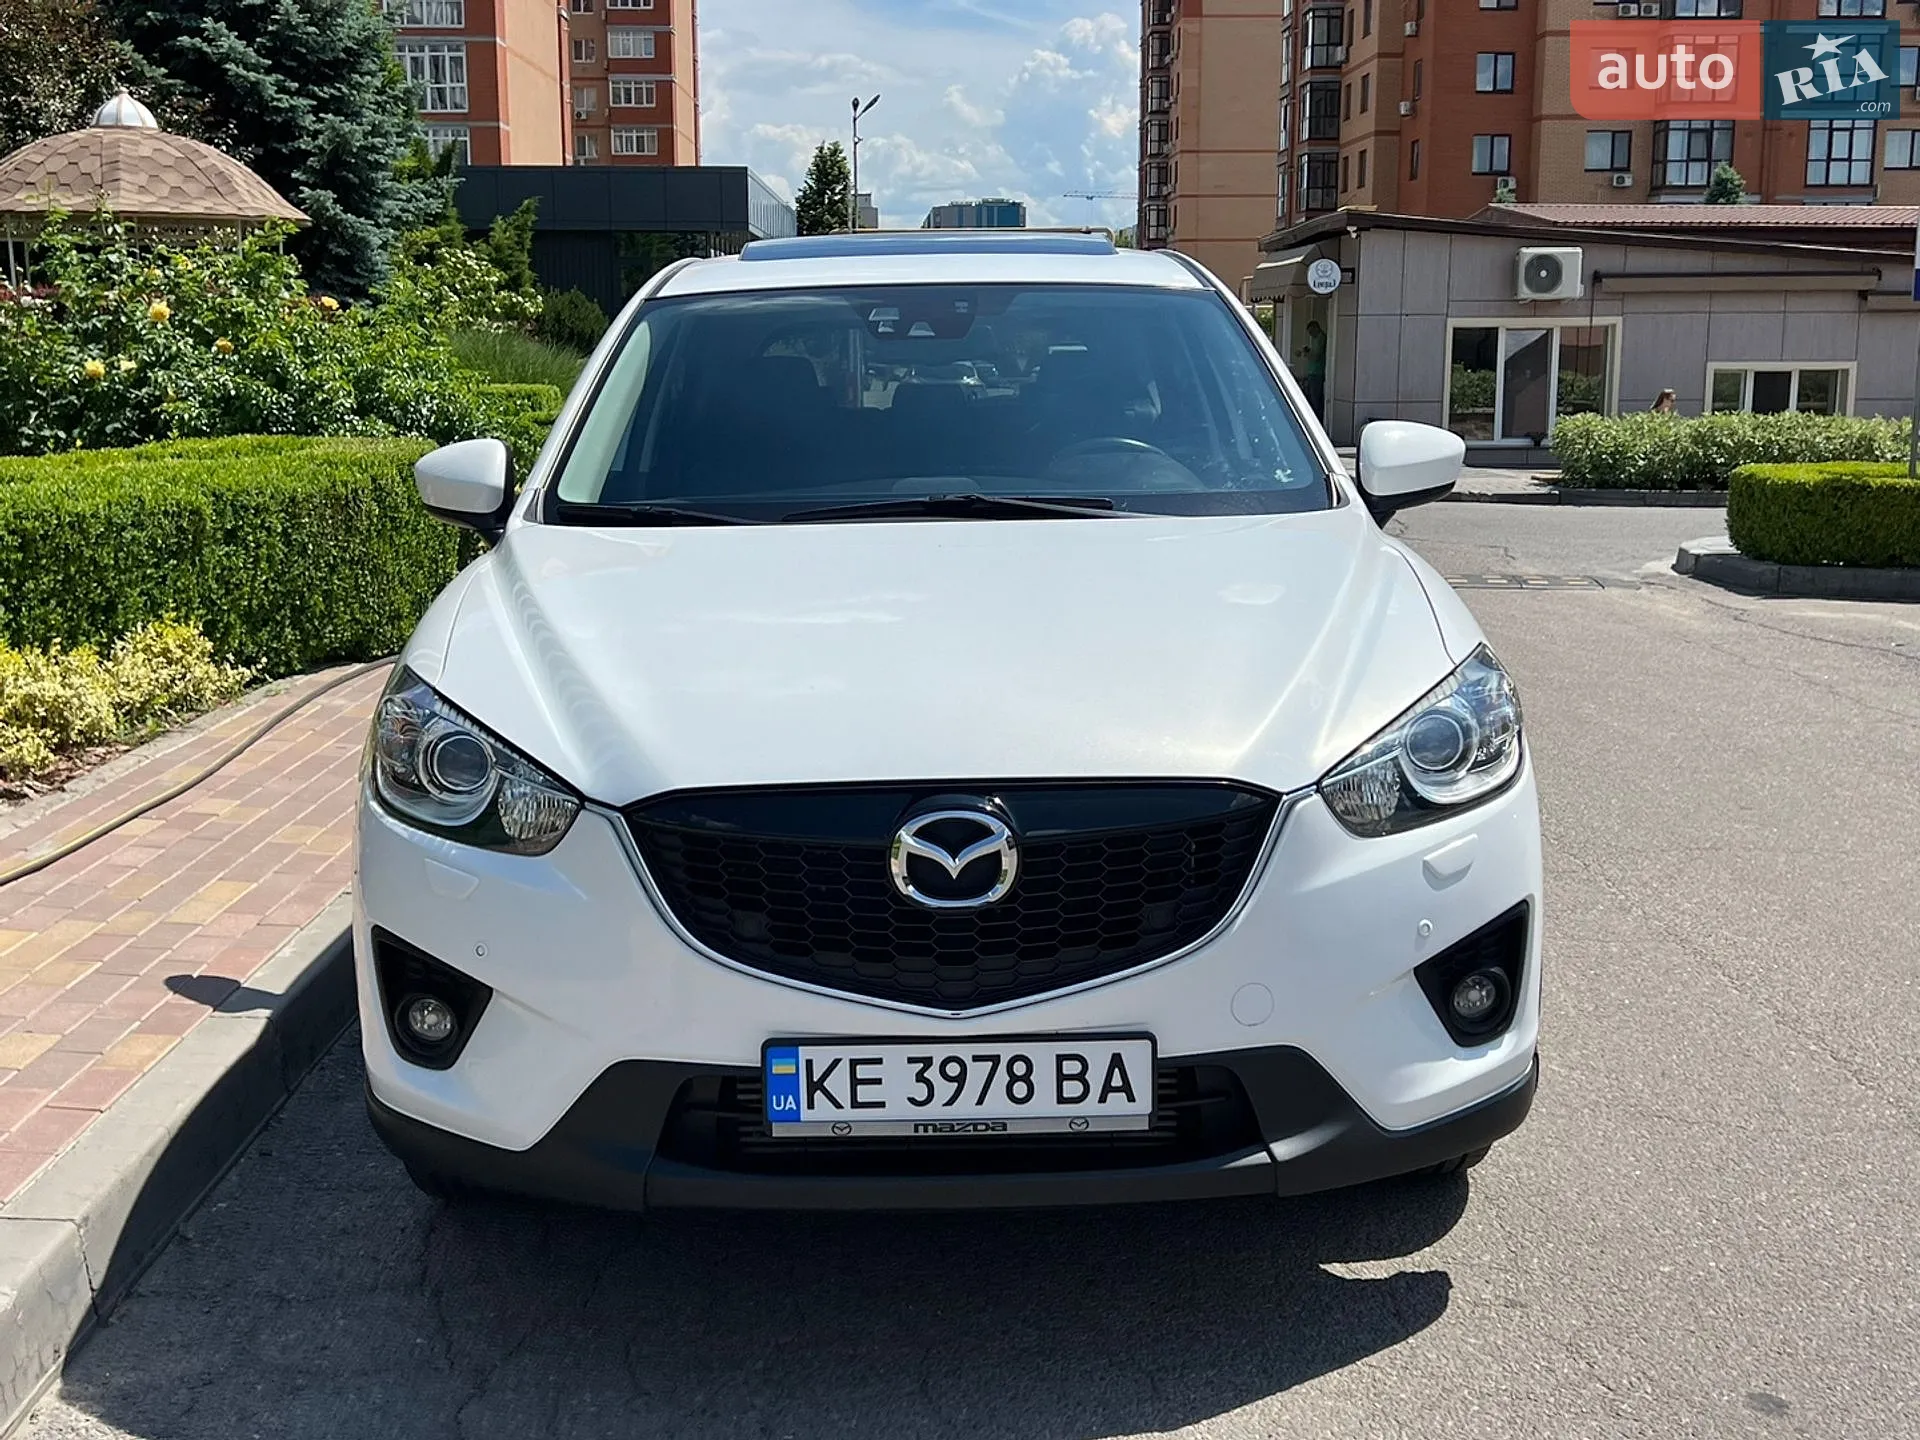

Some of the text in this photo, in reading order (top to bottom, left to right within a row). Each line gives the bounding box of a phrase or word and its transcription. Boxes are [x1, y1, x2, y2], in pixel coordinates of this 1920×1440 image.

[805, 1052, 1136, 1110] KE 3978 BA
[772, 1096, 797, 1111] UA
